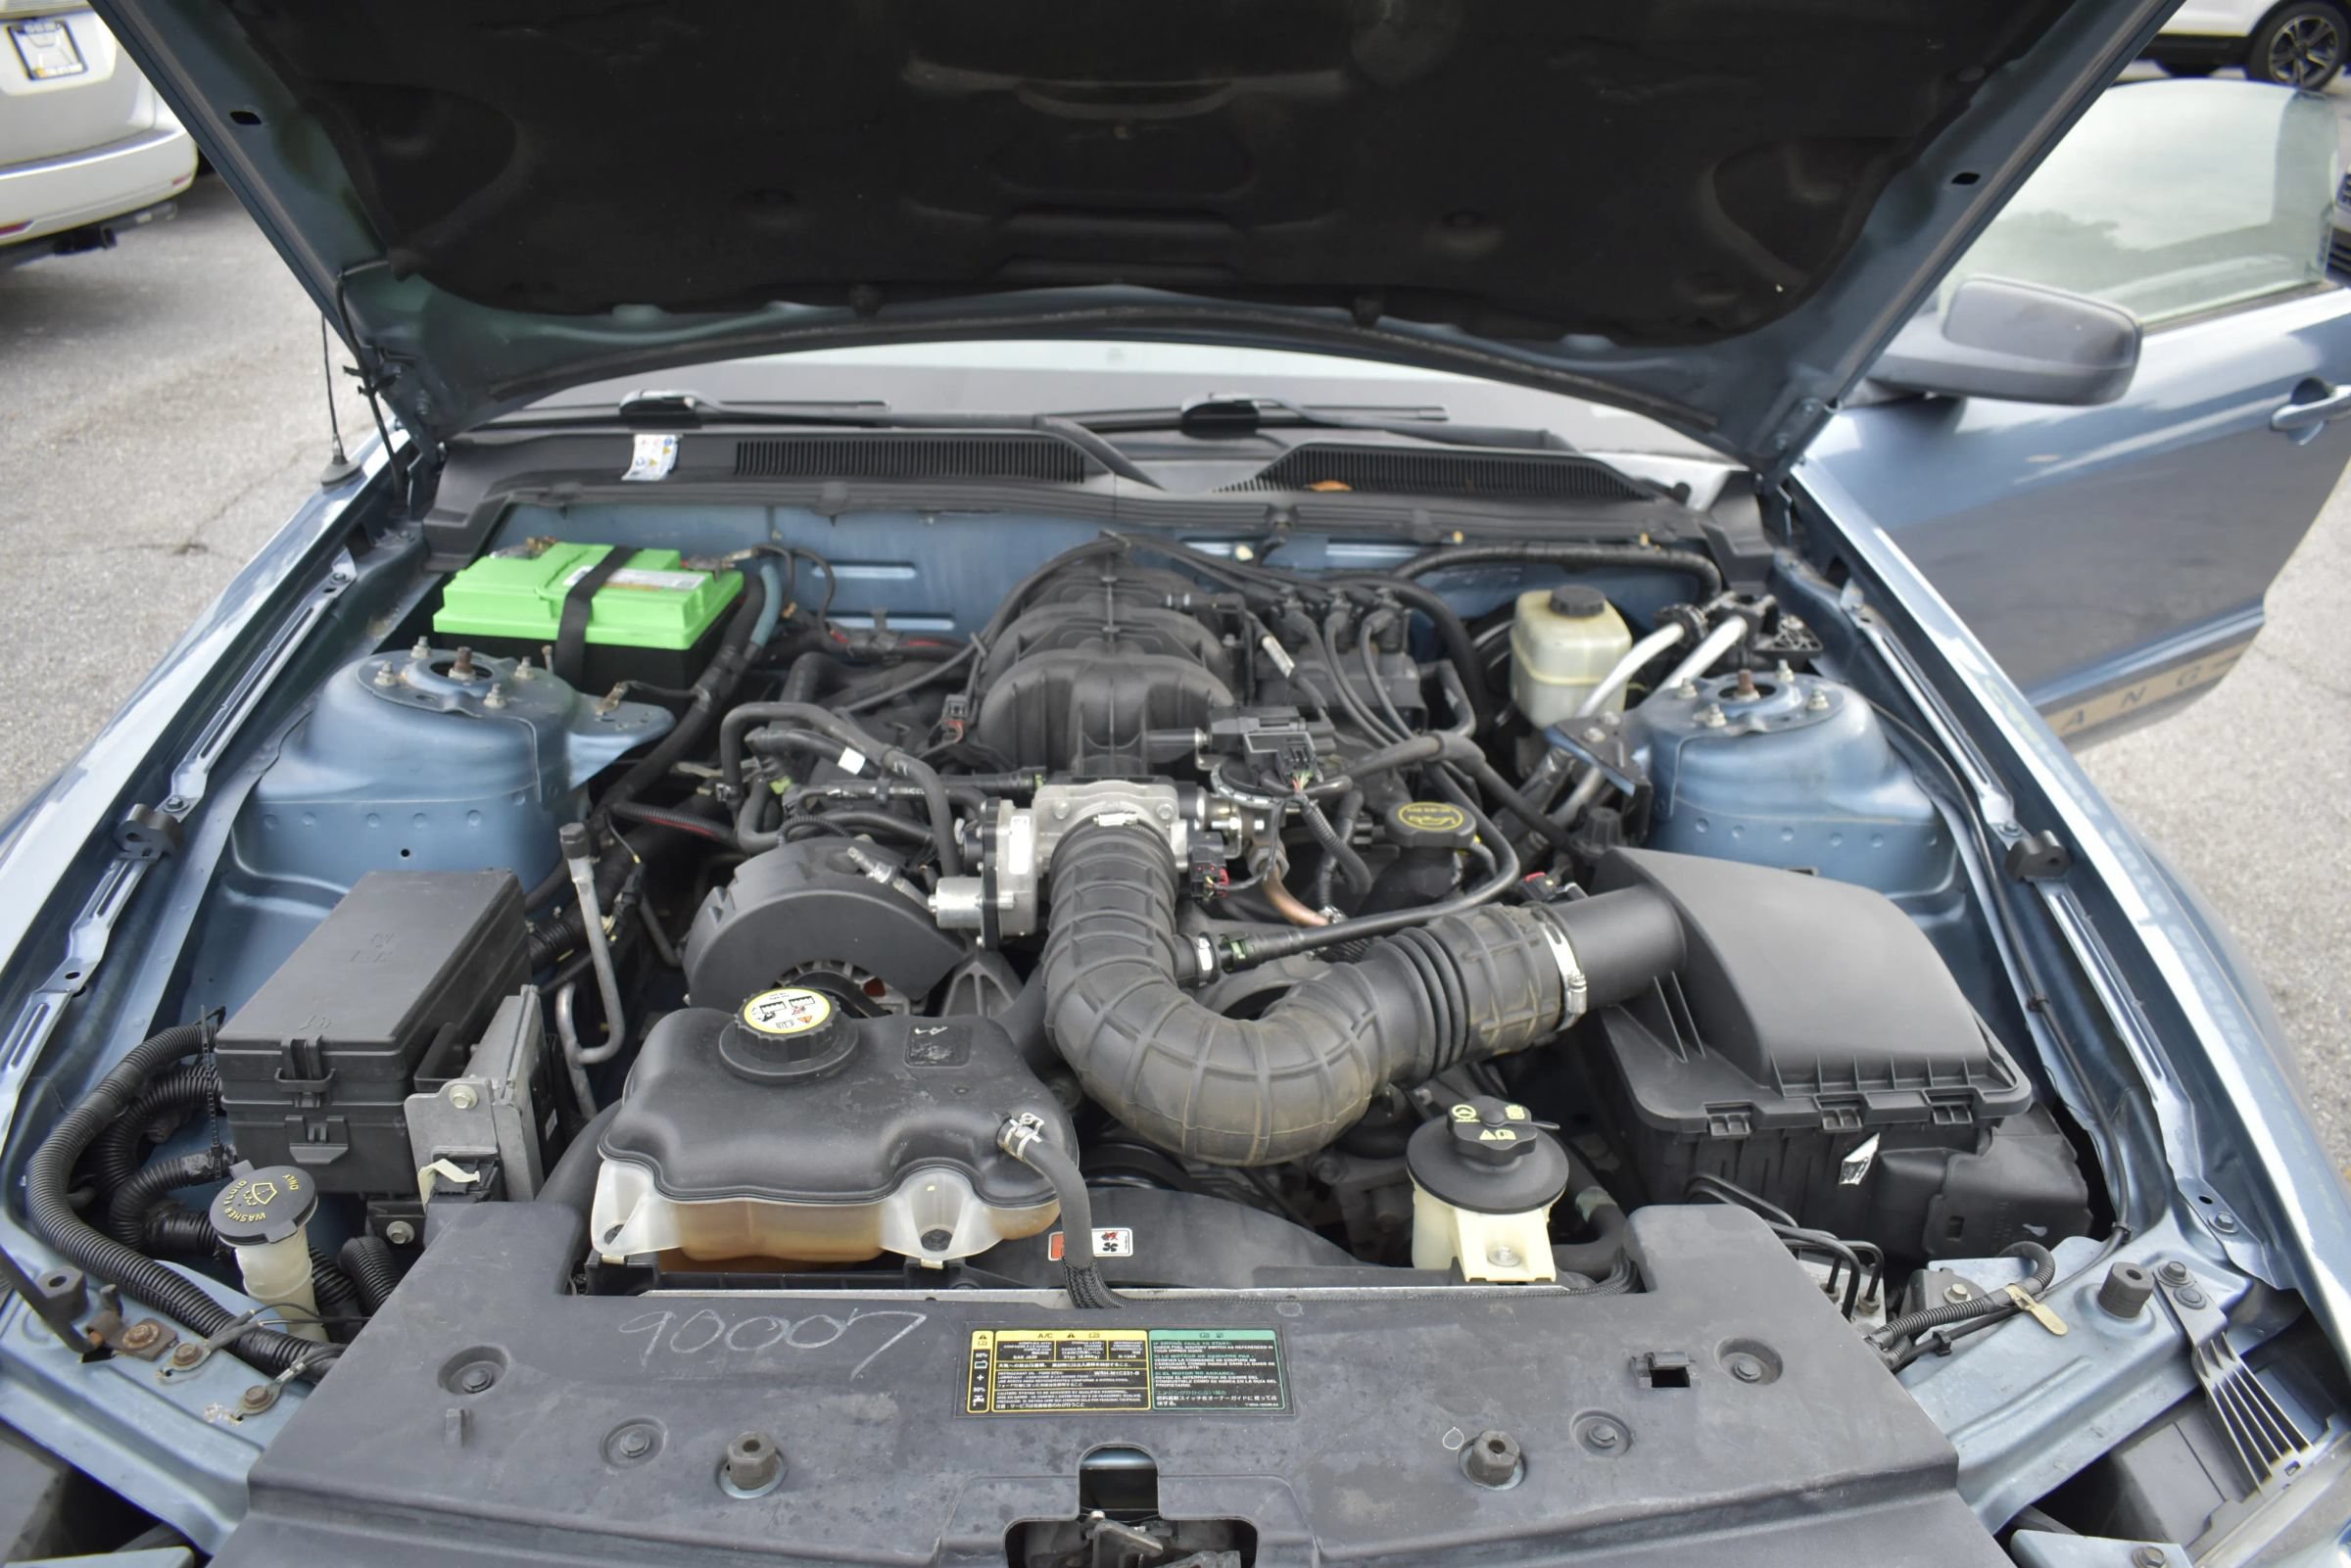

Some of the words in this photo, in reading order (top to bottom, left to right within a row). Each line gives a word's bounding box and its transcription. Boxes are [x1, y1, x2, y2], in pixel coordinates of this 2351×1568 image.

[282, 1173, 299, 1191] ONLY
[223, 1179, 247, 1206] FLUID
[223, 1206, 266, 1223] WASHER
